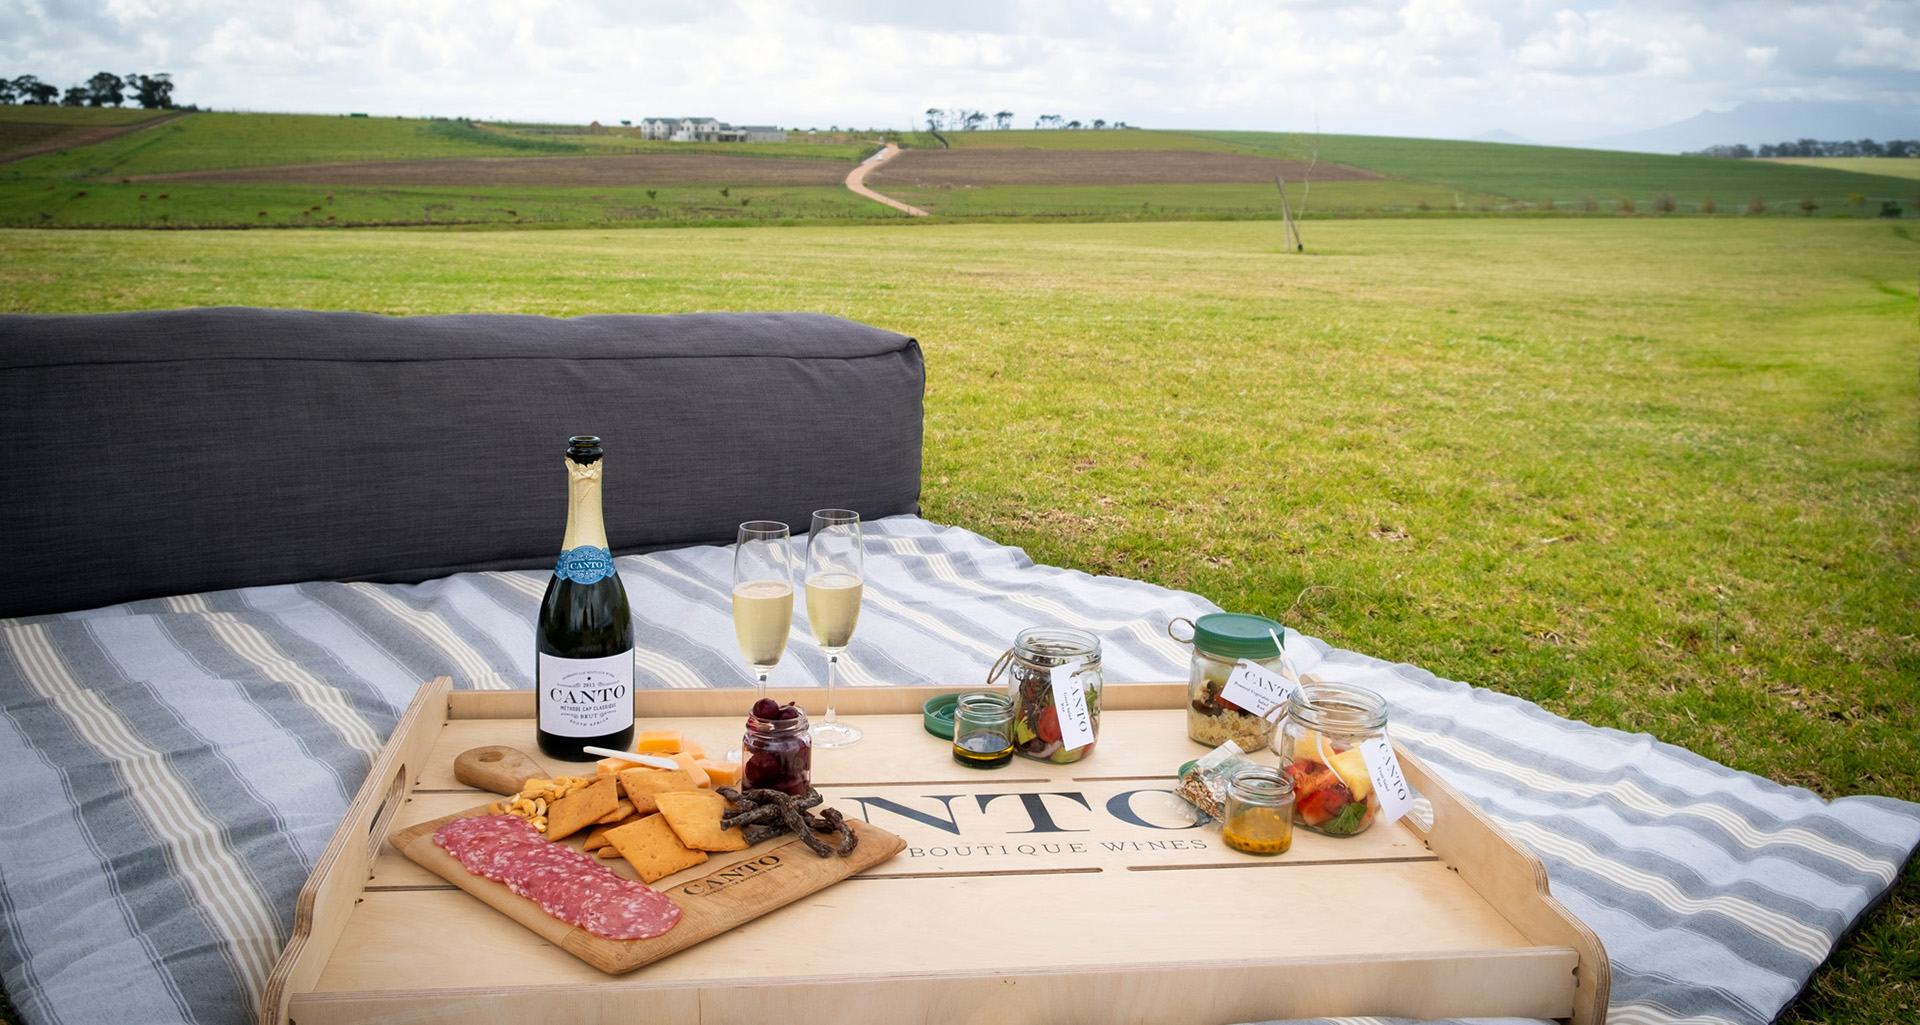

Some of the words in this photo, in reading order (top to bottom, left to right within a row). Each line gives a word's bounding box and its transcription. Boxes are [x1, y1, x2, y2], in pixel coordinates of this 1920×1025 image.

[570, 561, 603, 570] CANTO
[550, 684, 626, 705] CANTO
[1244, 671, 1291, 699] CANT
[593, 702, 617, 711] CLASSIQUE
[1069, 673, 1088, 732] CANTO
[589, 717, 609, 726] AFRICA
[1379, 743, 1406, 801] CANTO
[840, 789, 1210, 835] NTO
[909, 842, 1088, 858] BOUTIQUE
[1101, 839, 1208, 852] WINES
[683, 855, 780, 895] CANTO
